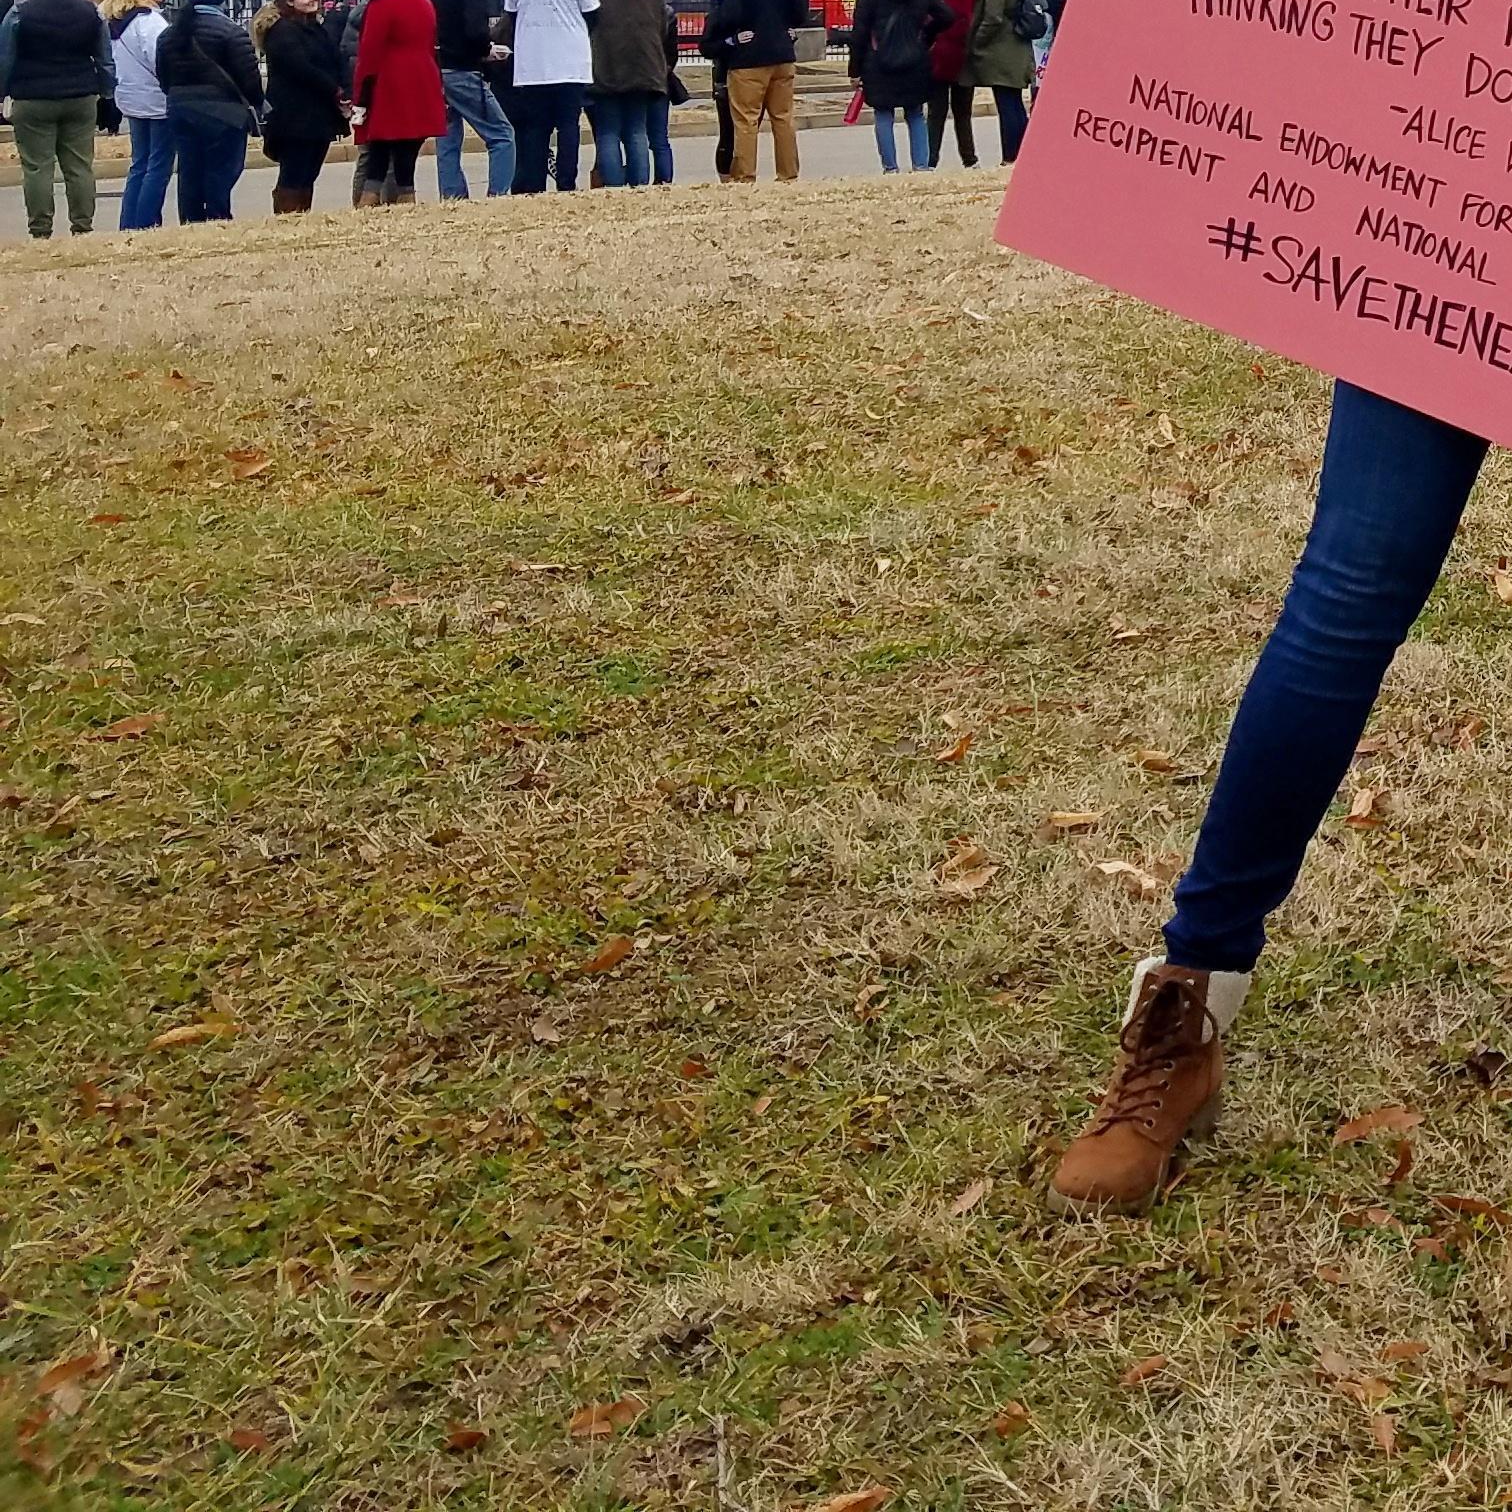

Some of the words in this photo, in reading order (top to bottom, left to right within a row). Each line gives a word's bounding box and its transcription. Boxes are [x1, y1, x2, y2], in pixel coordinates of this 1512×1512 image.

[1350, 13, 1444, 76] THEY
[1073, 109, 1226, 182] RECIPIENT
[1248, 172, 1315, 212] AND
[1356, 206, 1496, 285] NATIONAL
[1129, 74, 1263, 142] NATIONAL
[1280, 123, 1447, 207] ENDOWMENT
